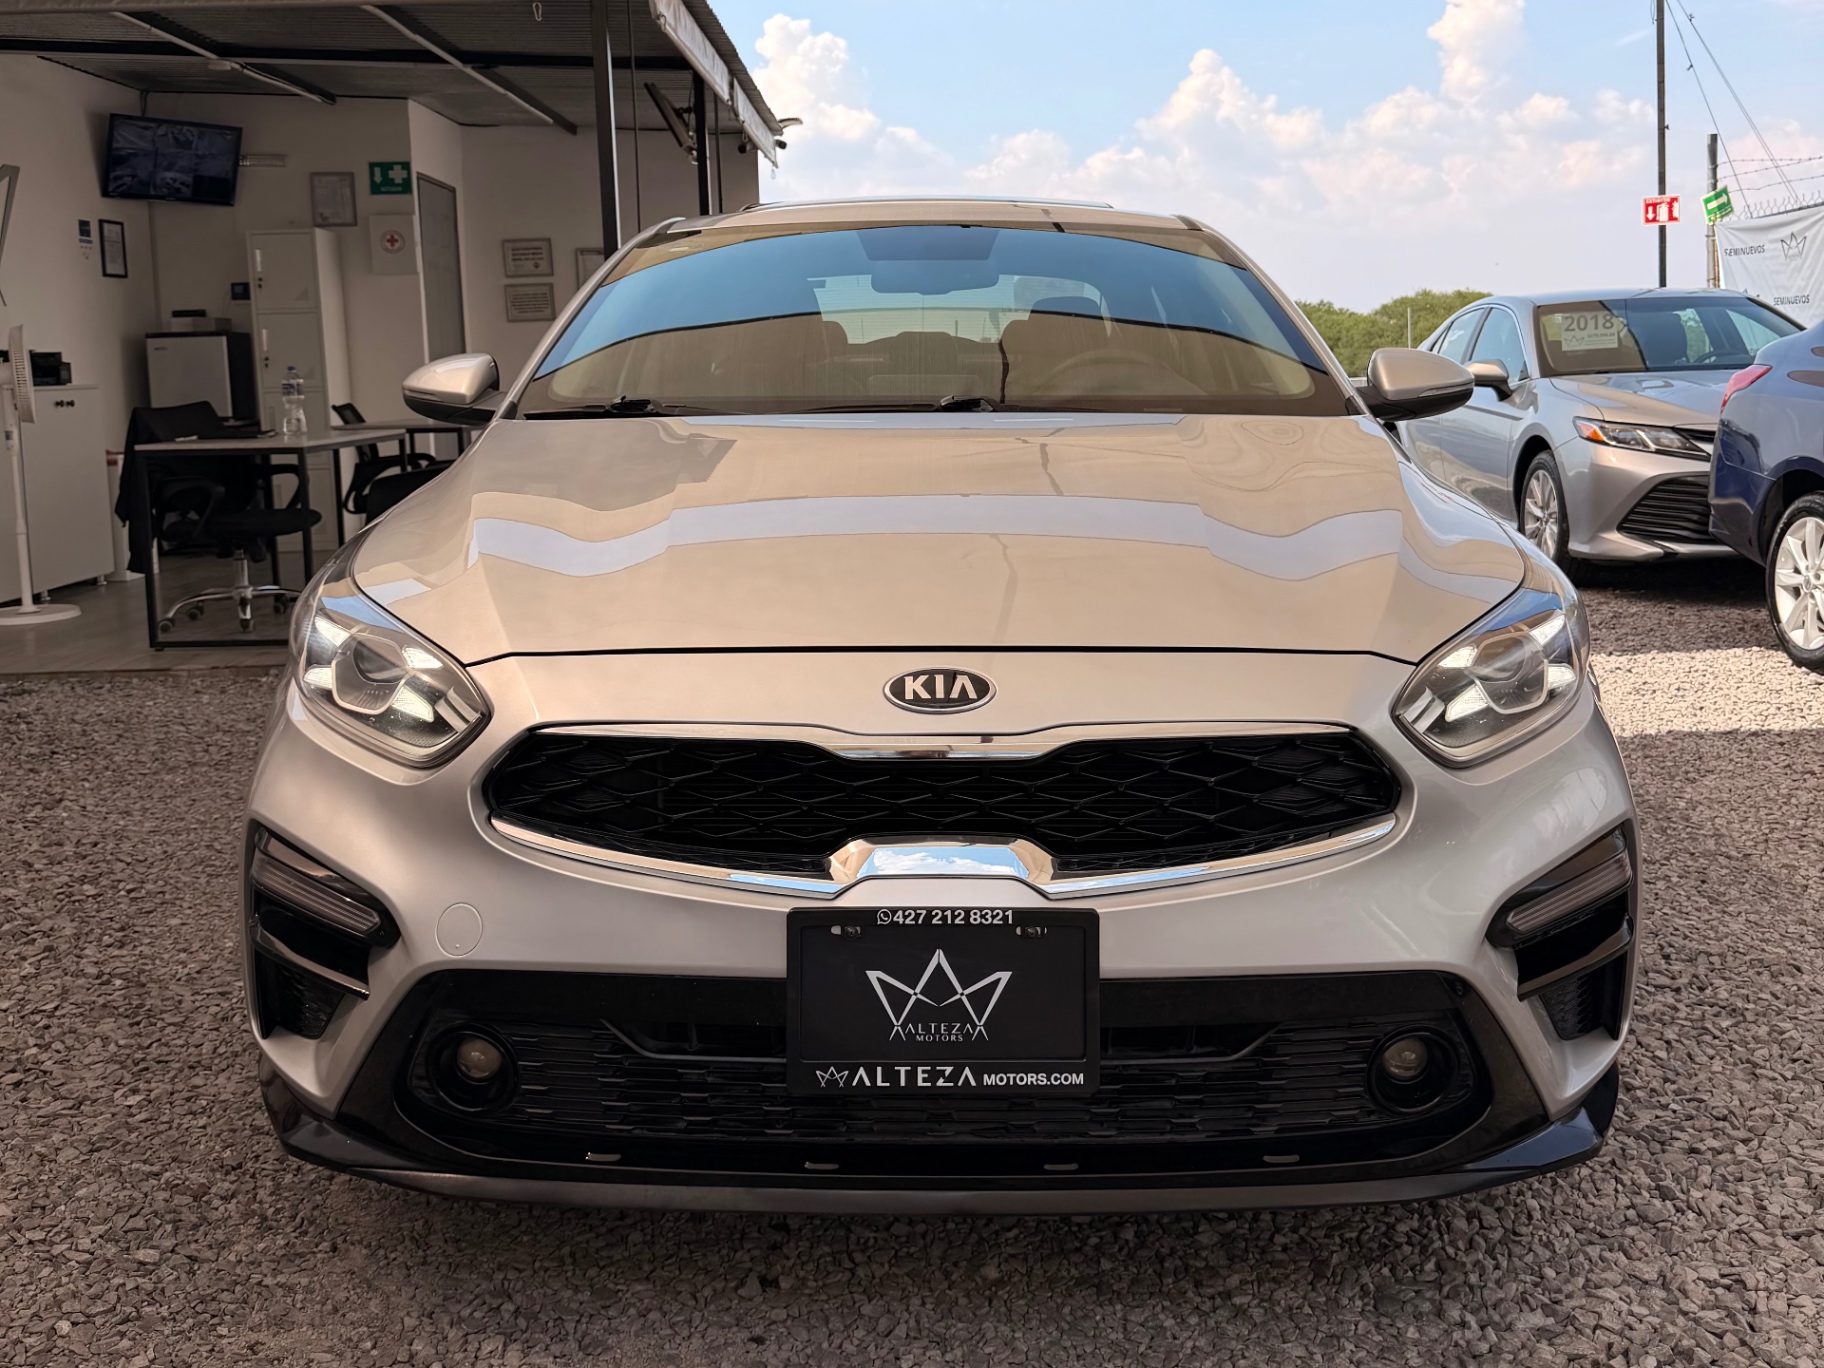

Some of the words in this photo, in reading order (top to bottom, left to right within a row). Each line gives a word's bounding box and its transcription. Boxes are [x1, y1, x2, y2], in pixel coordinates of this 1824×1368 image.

[1723, 244, 1766, 257] SEMINUEVOS
[1773, 294, 1810, 306] SEMINUEVOS
[1564, 313, 1615, 332] 2018
[903, 674, 978, 700] KIA
[893, 909, 925, 925] 427
[931, 909, 965, 925] 212
[969, 909, 1014, 925] 8321
[904, 1022, 974, 1034] ALTEZA
[915, 1034, 964, 1042] MOTORS
[851, 1066, 977, 1087] ALTEZA
[983, 1072, 1084, 1086] MOTORS.COM
